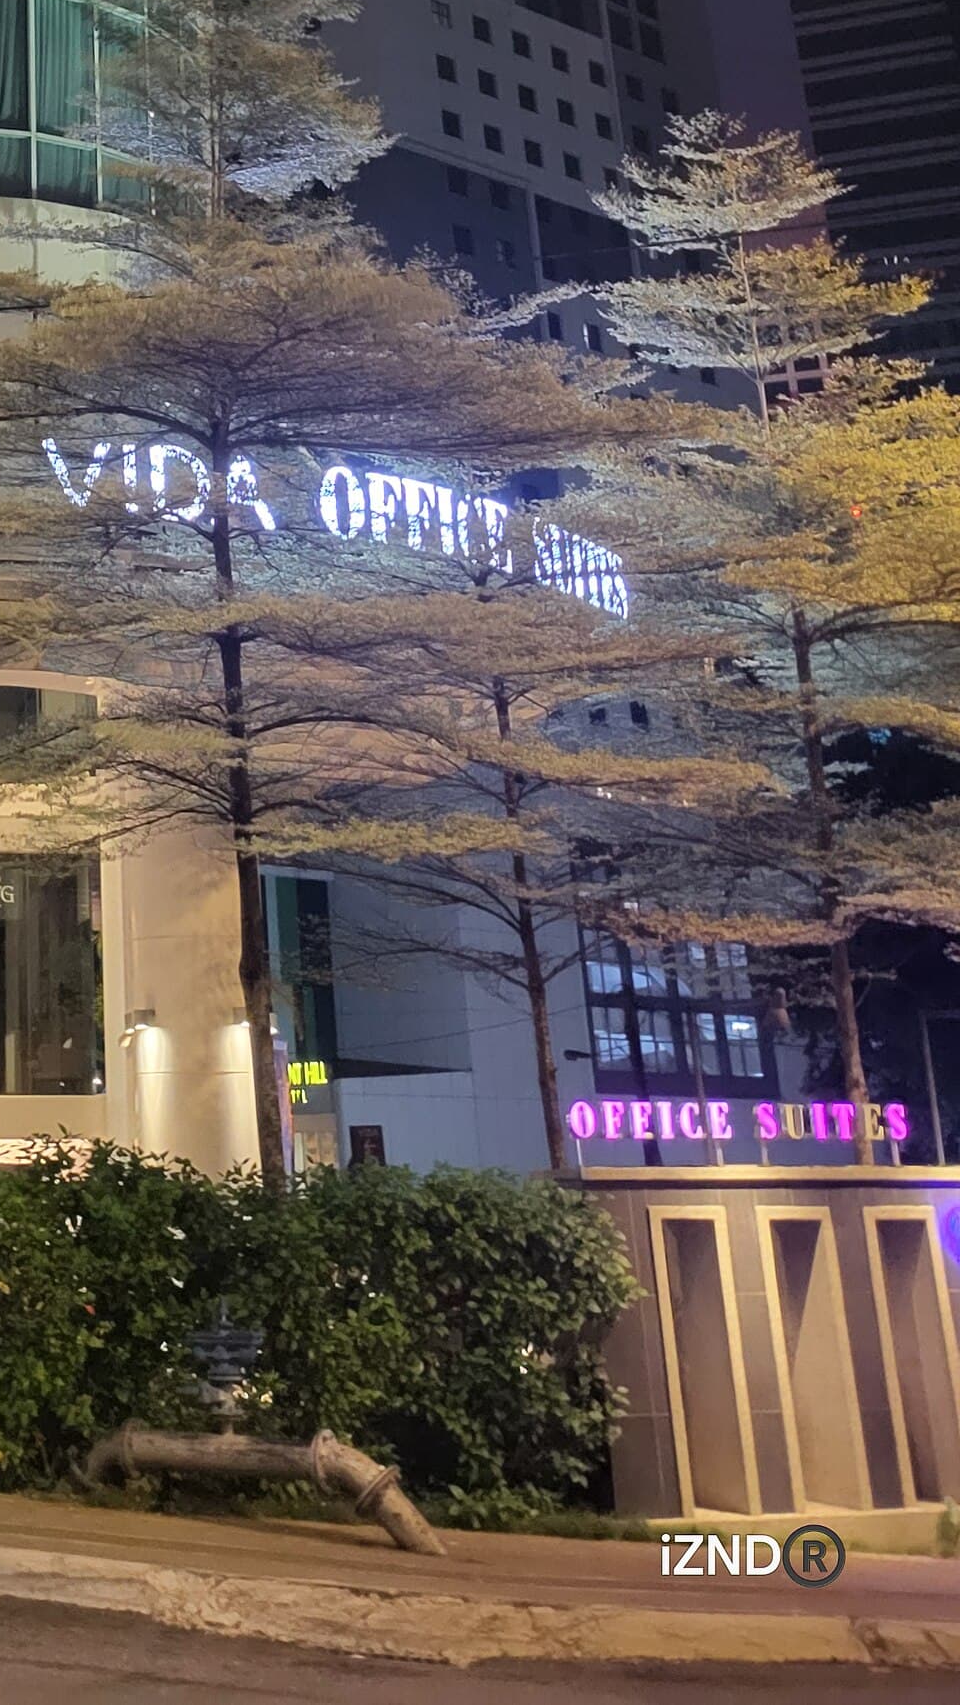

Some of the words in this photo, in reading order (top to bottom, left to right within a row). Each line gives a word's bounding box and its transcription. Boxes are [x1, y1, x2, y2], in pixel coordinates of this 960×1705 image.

[41, 437, 277, 532] VIDA
[318, 465, 514, 575] OFFICE
[568, 1098, 732, 1141] OFFICE
[753, 1100, 908, 1142] SUITES
